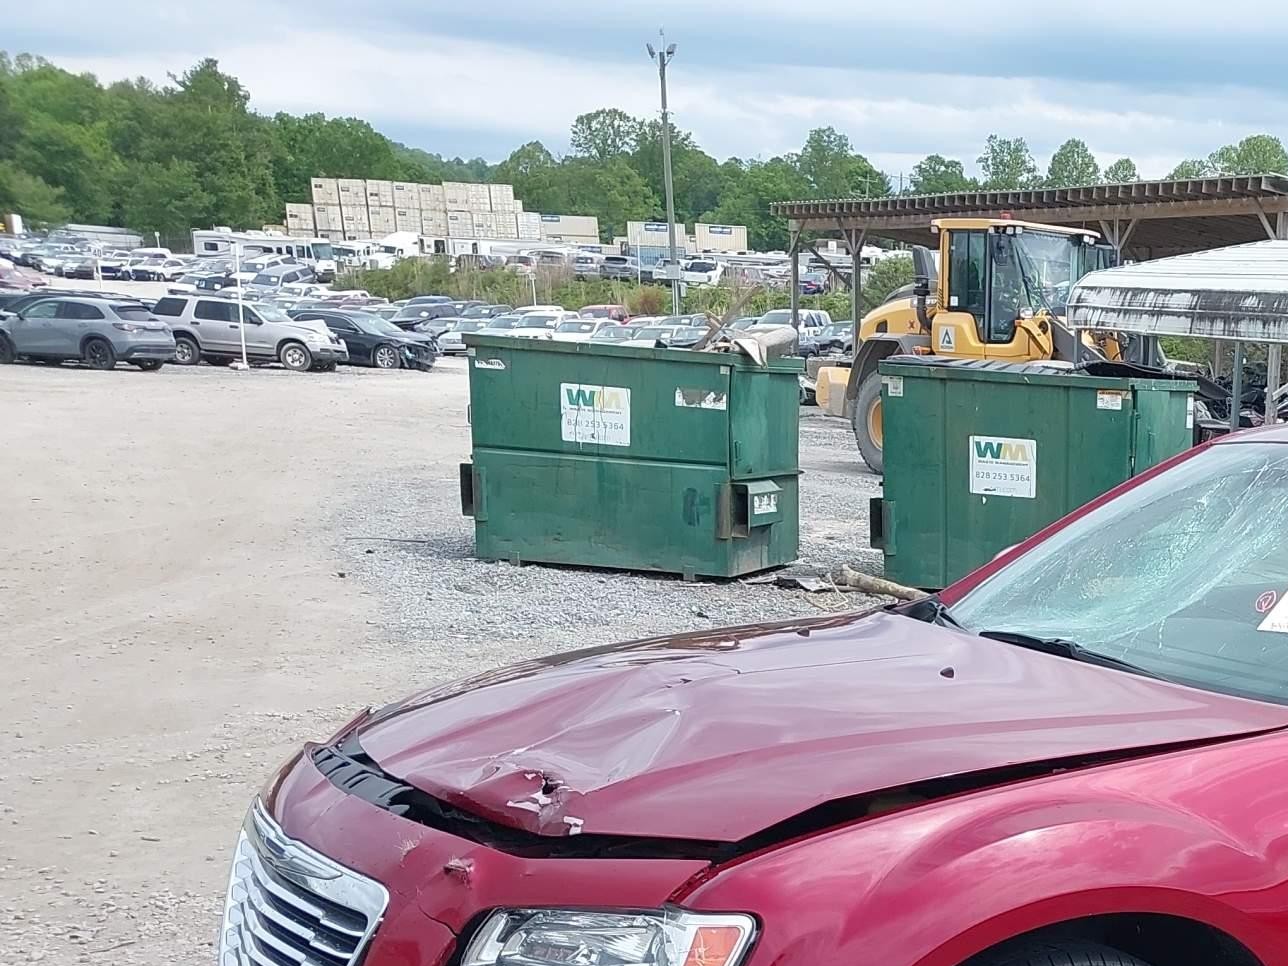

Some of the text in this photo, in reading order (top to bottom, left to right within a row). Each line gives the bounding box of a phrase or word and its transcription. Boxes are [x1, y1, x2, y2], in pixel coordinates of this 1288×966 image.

[975, 441, 1028, 461] WM
[975, 471, 991, 479] 828
[993, 473, 1007, 481] 253
